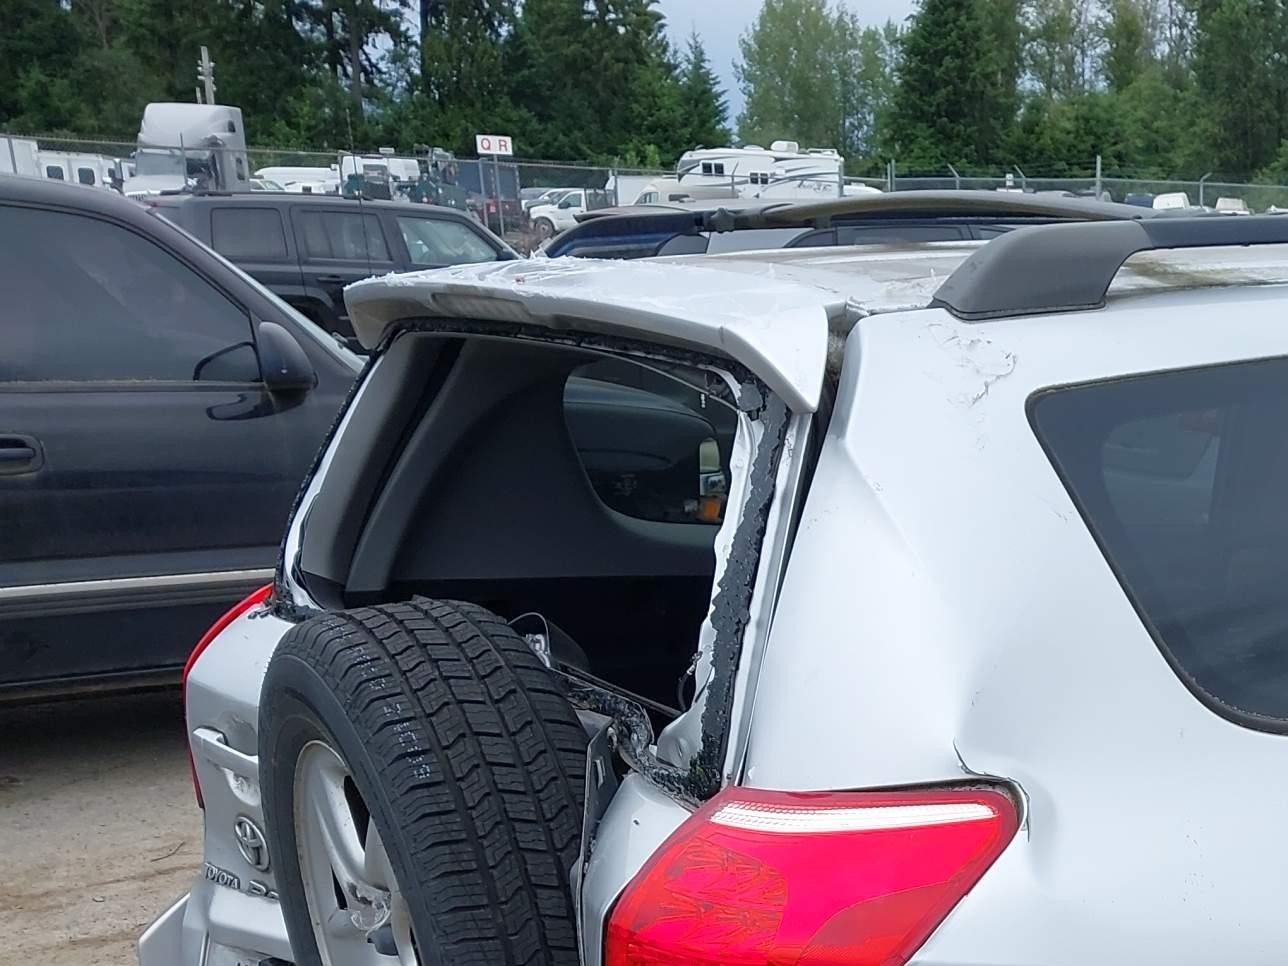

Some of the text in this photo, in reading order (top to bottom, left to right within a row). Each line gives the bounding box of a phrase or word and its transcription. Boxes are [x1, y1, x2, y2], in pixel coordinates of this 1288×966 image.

[481, 138, 508, 151] Q R
[204, 862, 241, 889] TOYOTA
